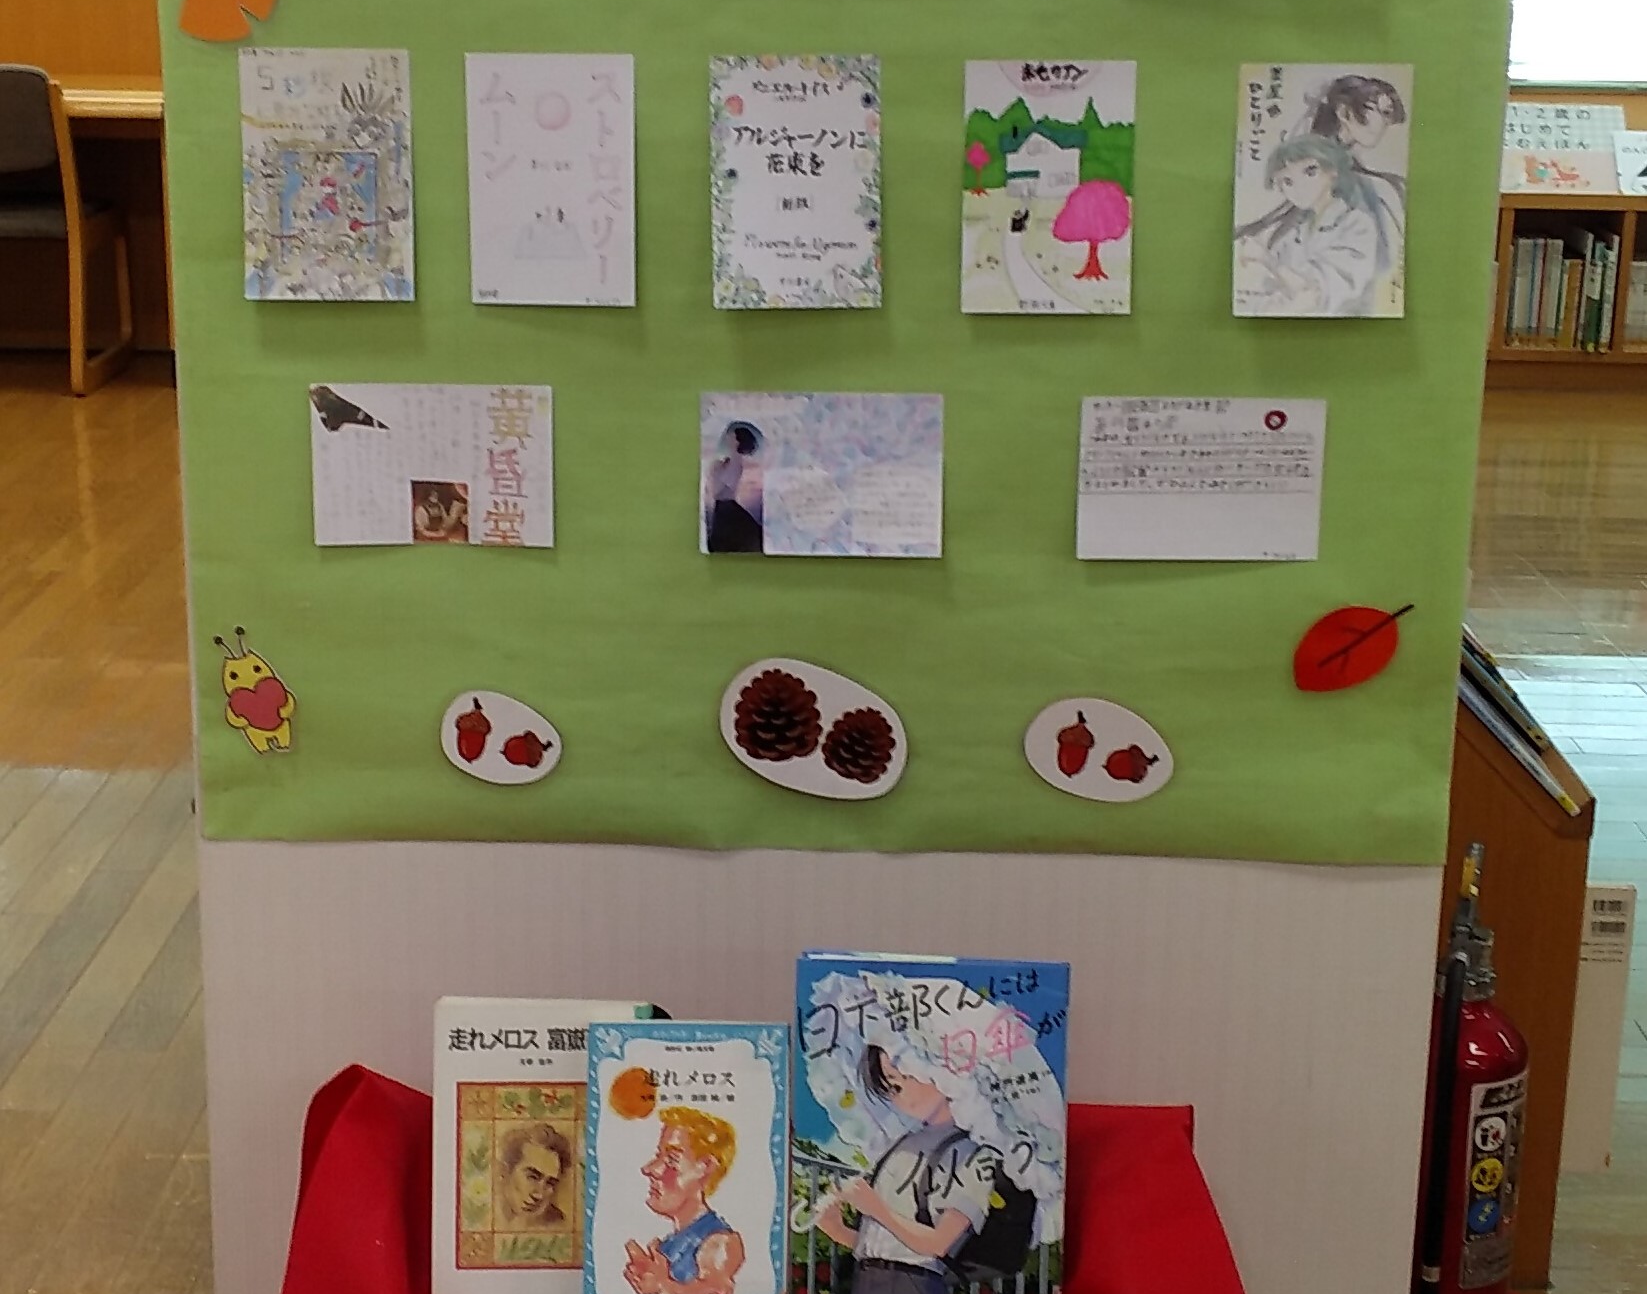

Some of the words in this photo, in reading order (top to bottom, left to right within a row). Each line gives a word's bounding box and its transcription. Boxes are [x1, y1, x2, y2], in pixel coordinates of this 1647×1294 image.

[733, 126, 868, 149] アルジャーノンに
[767, 151, 825, 177] 花束を
[798, 968, 1041, 1060] 日下部くんには
[448, 1027, 539, 1051] 走れメロス
[943, 1007, 1068, 1076] 日傘が
[644, 1068, 737, 1087] 走れメロス
